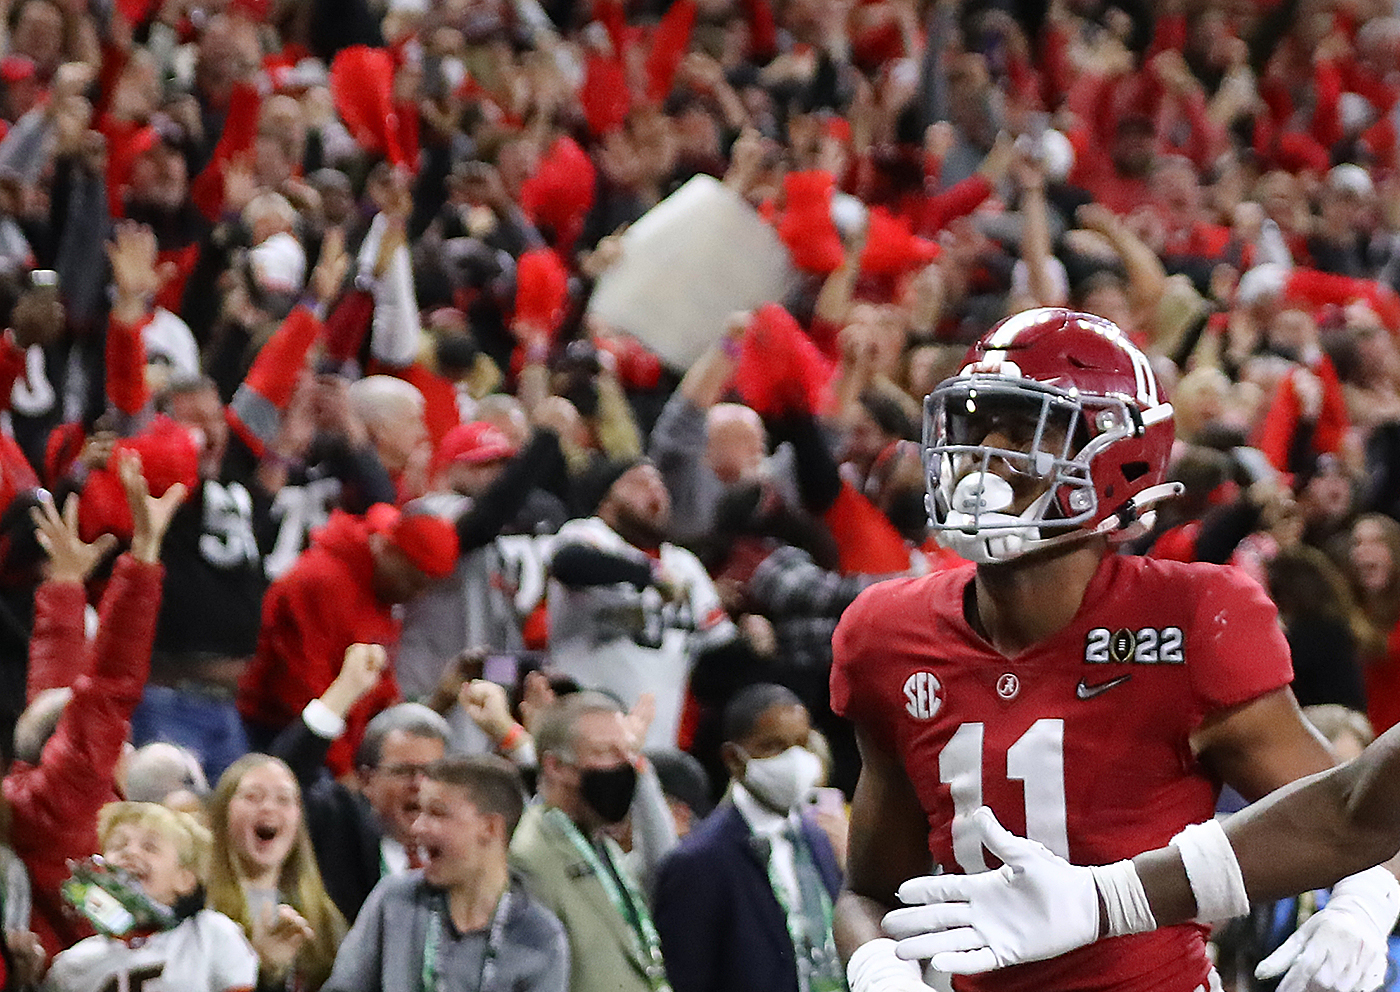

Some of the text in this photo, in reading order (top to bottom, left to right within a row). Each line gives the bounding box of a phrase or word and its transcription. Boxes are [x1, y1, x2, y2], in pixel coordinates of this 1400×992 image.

[1084, 626, 1186, 663] 2022
[903, 672, 942, 719] SEC
[938, 718, 1070, 875] 11
